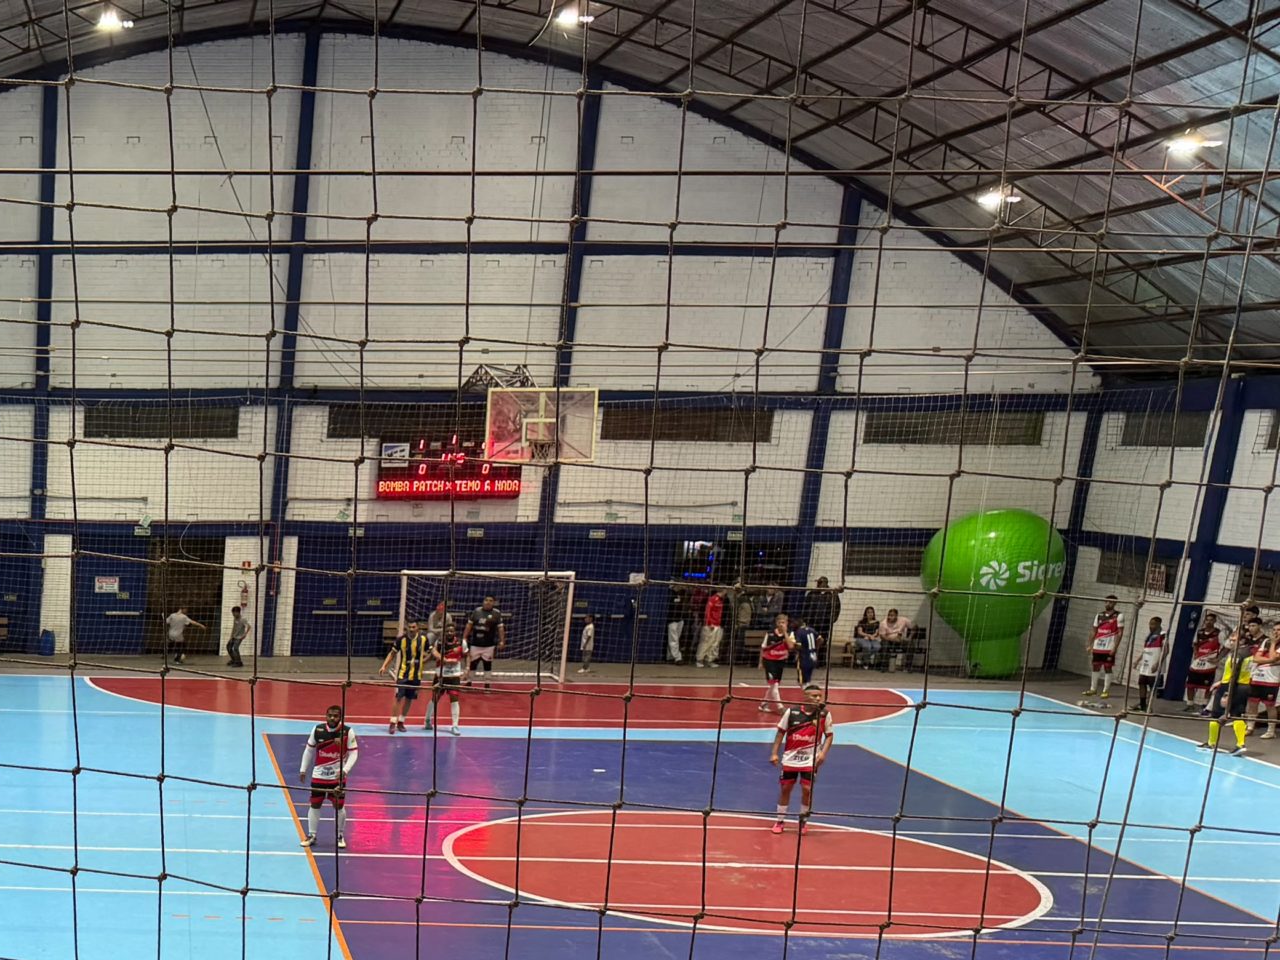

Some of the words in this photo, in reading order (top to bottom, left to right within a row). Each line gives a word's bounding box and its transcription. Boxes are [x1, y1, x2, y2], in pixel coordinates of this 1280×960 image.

[378, 481, 410, 492] BOMBA
[413, 480, 445, 492] PATCH
[455, 480, 481, 492] TEMO
[495, 480, 519, 491] NADA
